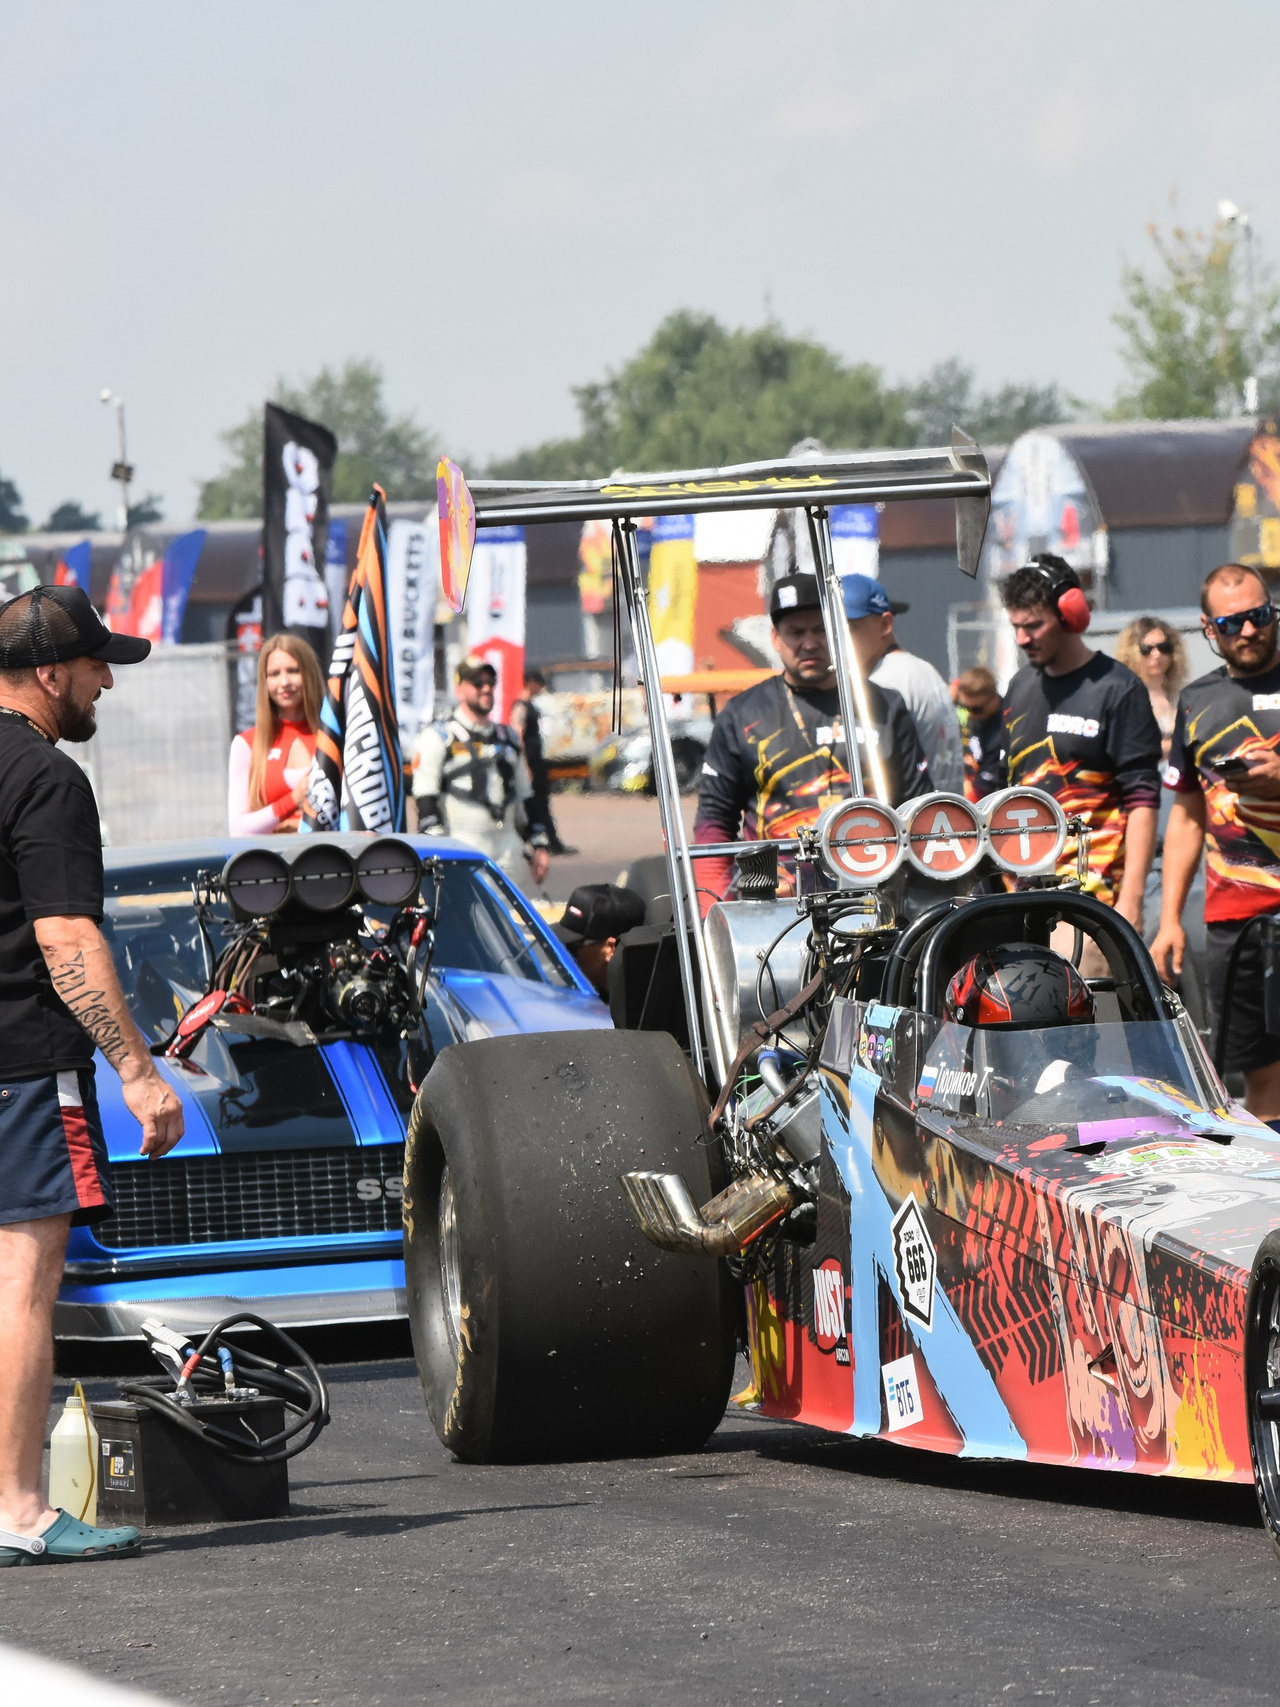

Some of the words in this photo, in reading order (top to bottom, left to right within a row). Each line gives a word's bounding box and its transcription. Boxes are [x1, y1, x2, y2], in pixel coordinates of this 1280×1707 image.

[935, 1061, 978, 1102] Тюриков
[906, 1243, 928, 1284] 666
[895, 1379, 915, 1418] ВТБ
